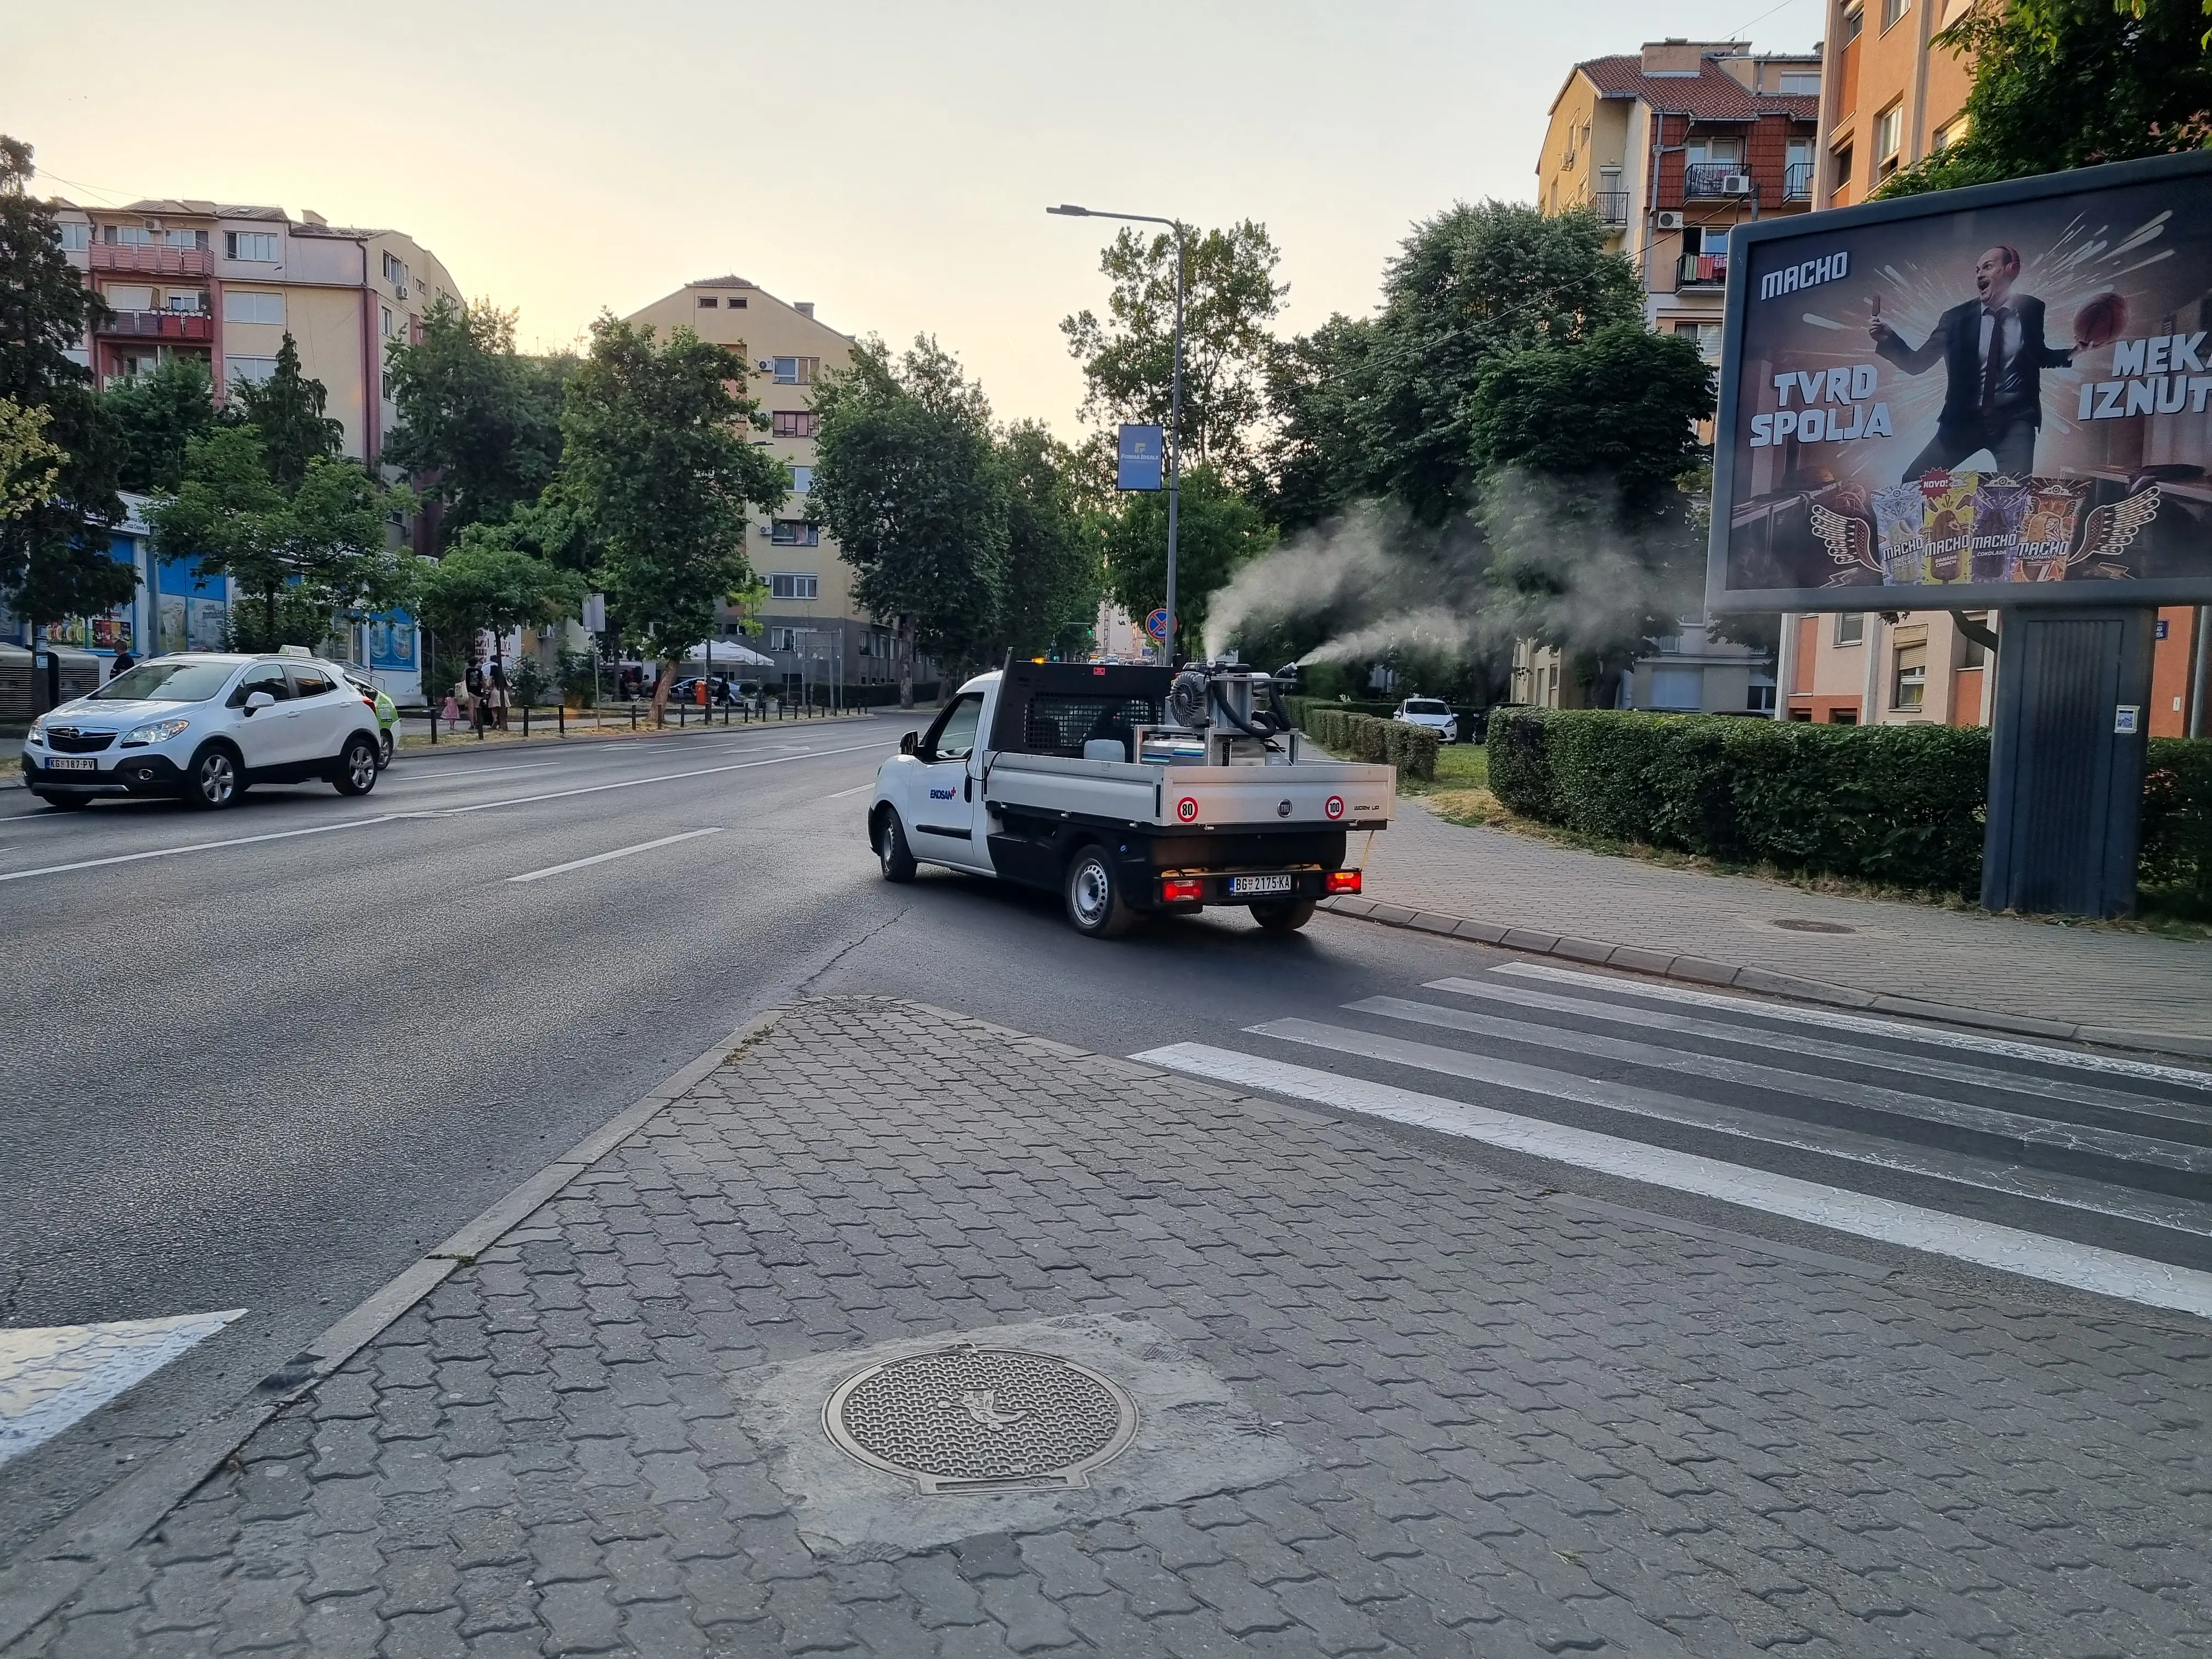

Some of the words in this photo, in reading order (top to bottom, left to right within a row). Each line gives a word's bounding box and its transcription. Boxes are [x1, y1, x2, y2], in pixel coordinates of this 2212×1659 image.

[1760, 251, 1848, 300] MACHO
[2112, 331, 2212, 377] MEK
[1774, 364, 1878, 407] TVRD
[1749, 402, 1892, 448] SPOLJA
[1923, 479, 1949, 489] NOVO!
[1925, 534, 1969, 557] MACHO
[1972, 533, 2017, 549] MACHO
[1883, 537, 1923, 560] MACHO
[2016, 541, 2069, 556] MACHO
[1935, 555, 1957, 563] BANANA
[1936, 559, 1956, 568] CRUNCH
[50, 759, 60, 768] KG
[930, 789, 952, 800] EKOSAN
[1182, 803, 1193, 816] 80
[1329, 802, 1340, 813] 100
[1236, 878, 1248, 891] BG
